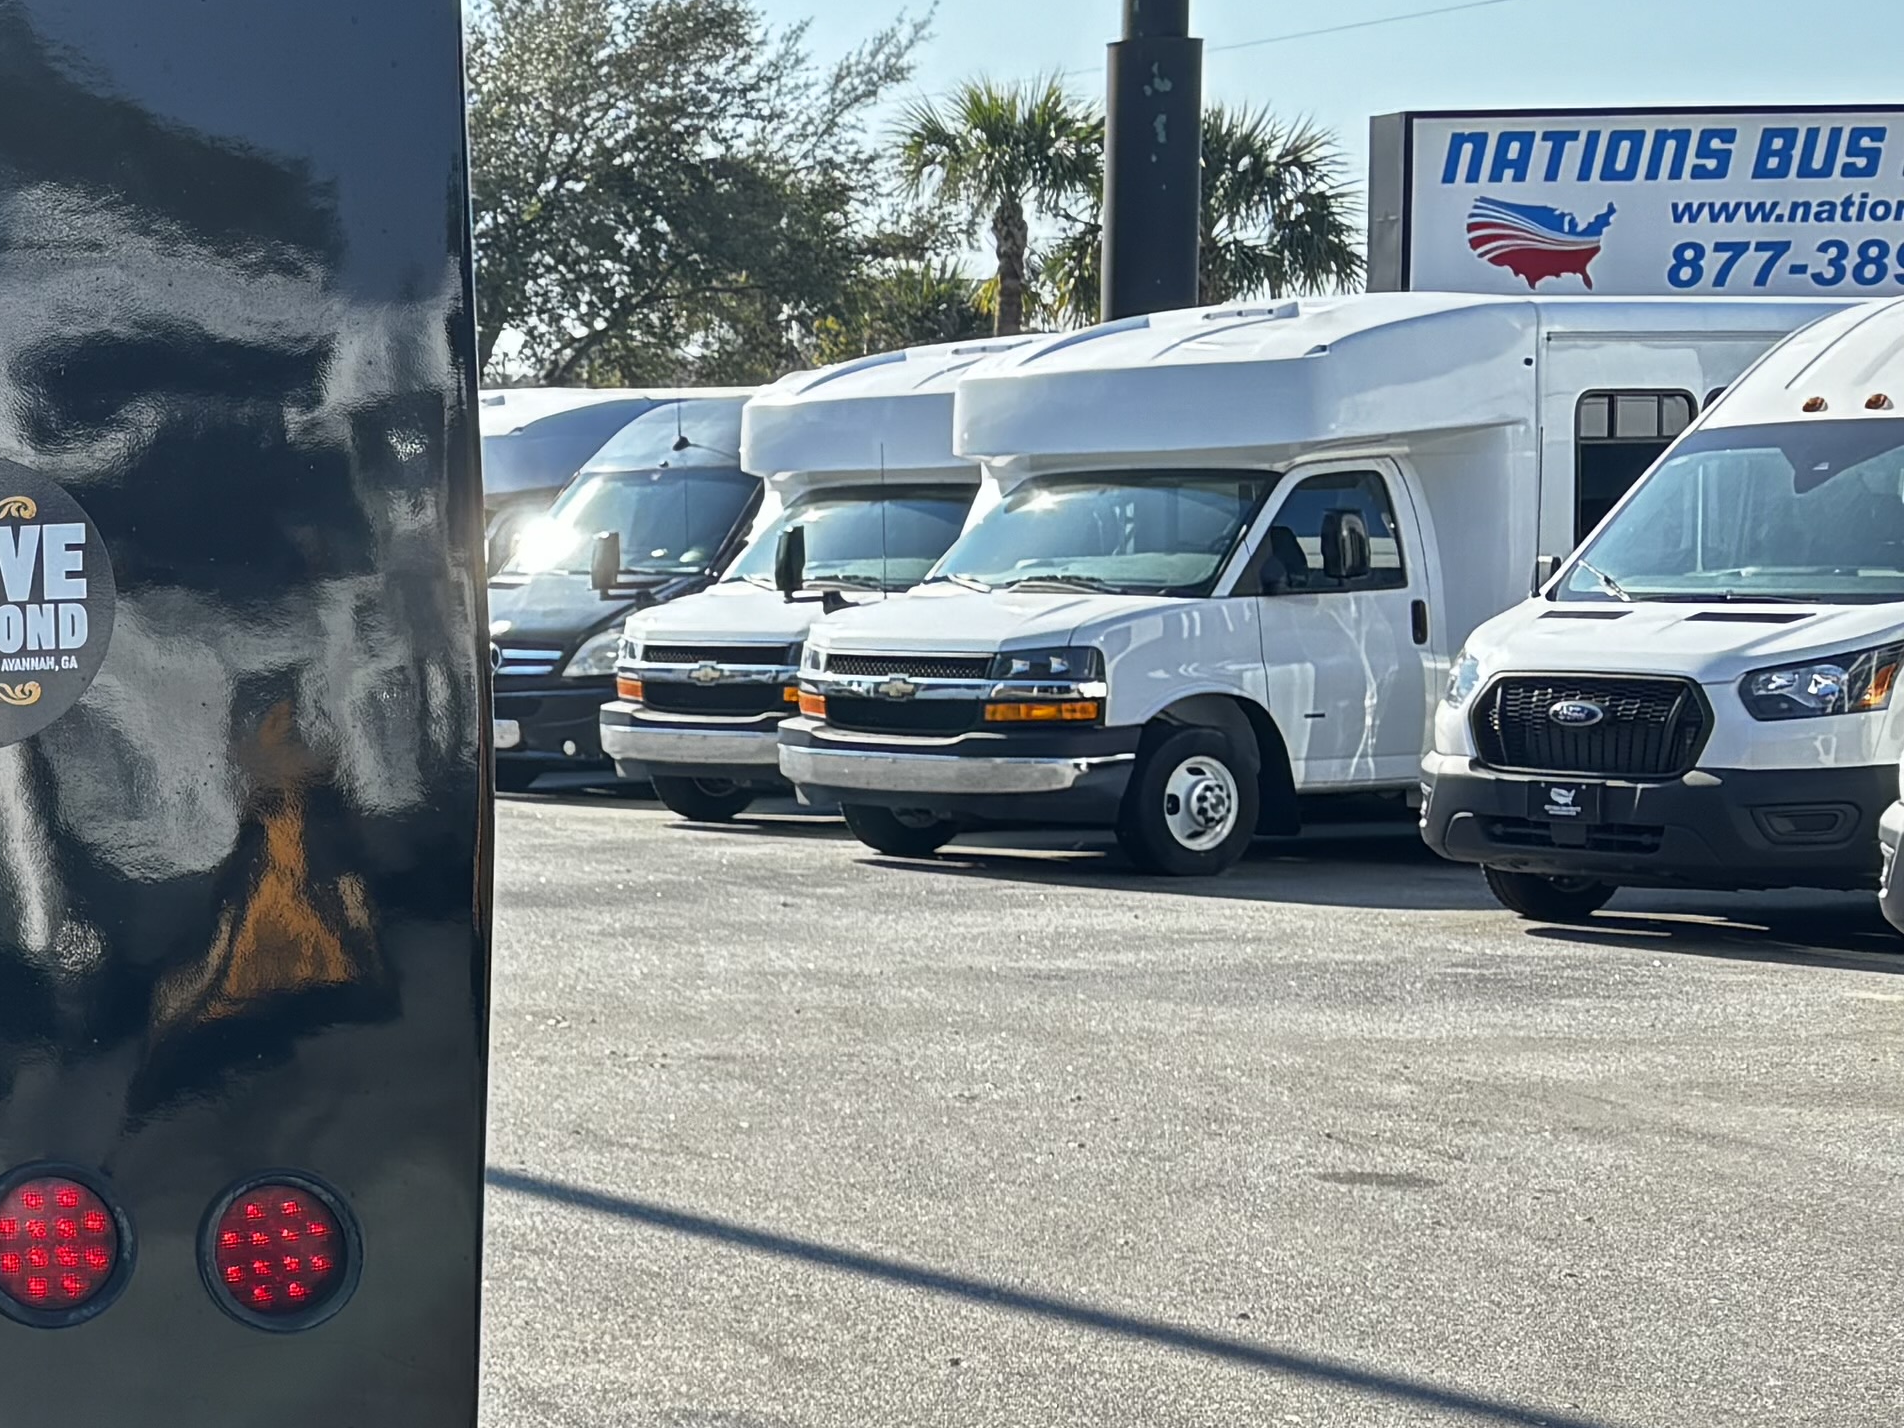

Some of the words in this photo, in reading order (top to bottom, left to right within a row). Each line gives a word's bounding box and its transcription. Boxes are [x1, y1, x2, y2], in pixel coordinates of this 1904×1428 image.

[1441, 128, 1737, 184] NATIONS
[1751, 126, 1887, 180] BUS
[1667, 238, 1904, 289] 877-38
[61, 655, 78, 670] GA
